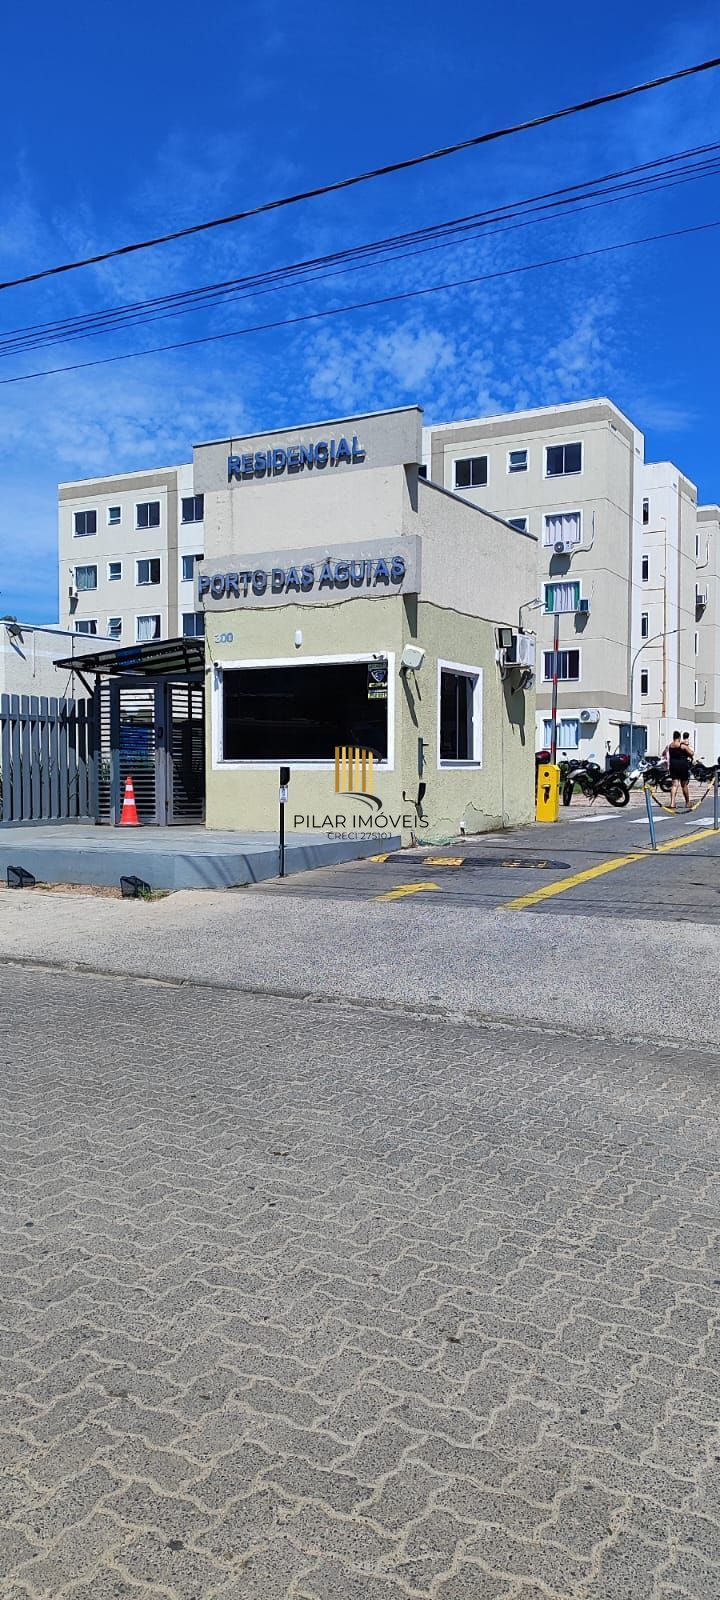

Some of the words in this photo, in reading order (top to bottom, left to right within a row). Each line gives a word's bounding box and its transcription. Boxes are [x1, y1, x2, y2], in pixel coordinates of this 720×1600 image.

[227, 436, 366, 481] RESIDENCIAL
[198, 569, 268, 601] PORTO
[271, 564, 315, 594] DAS
